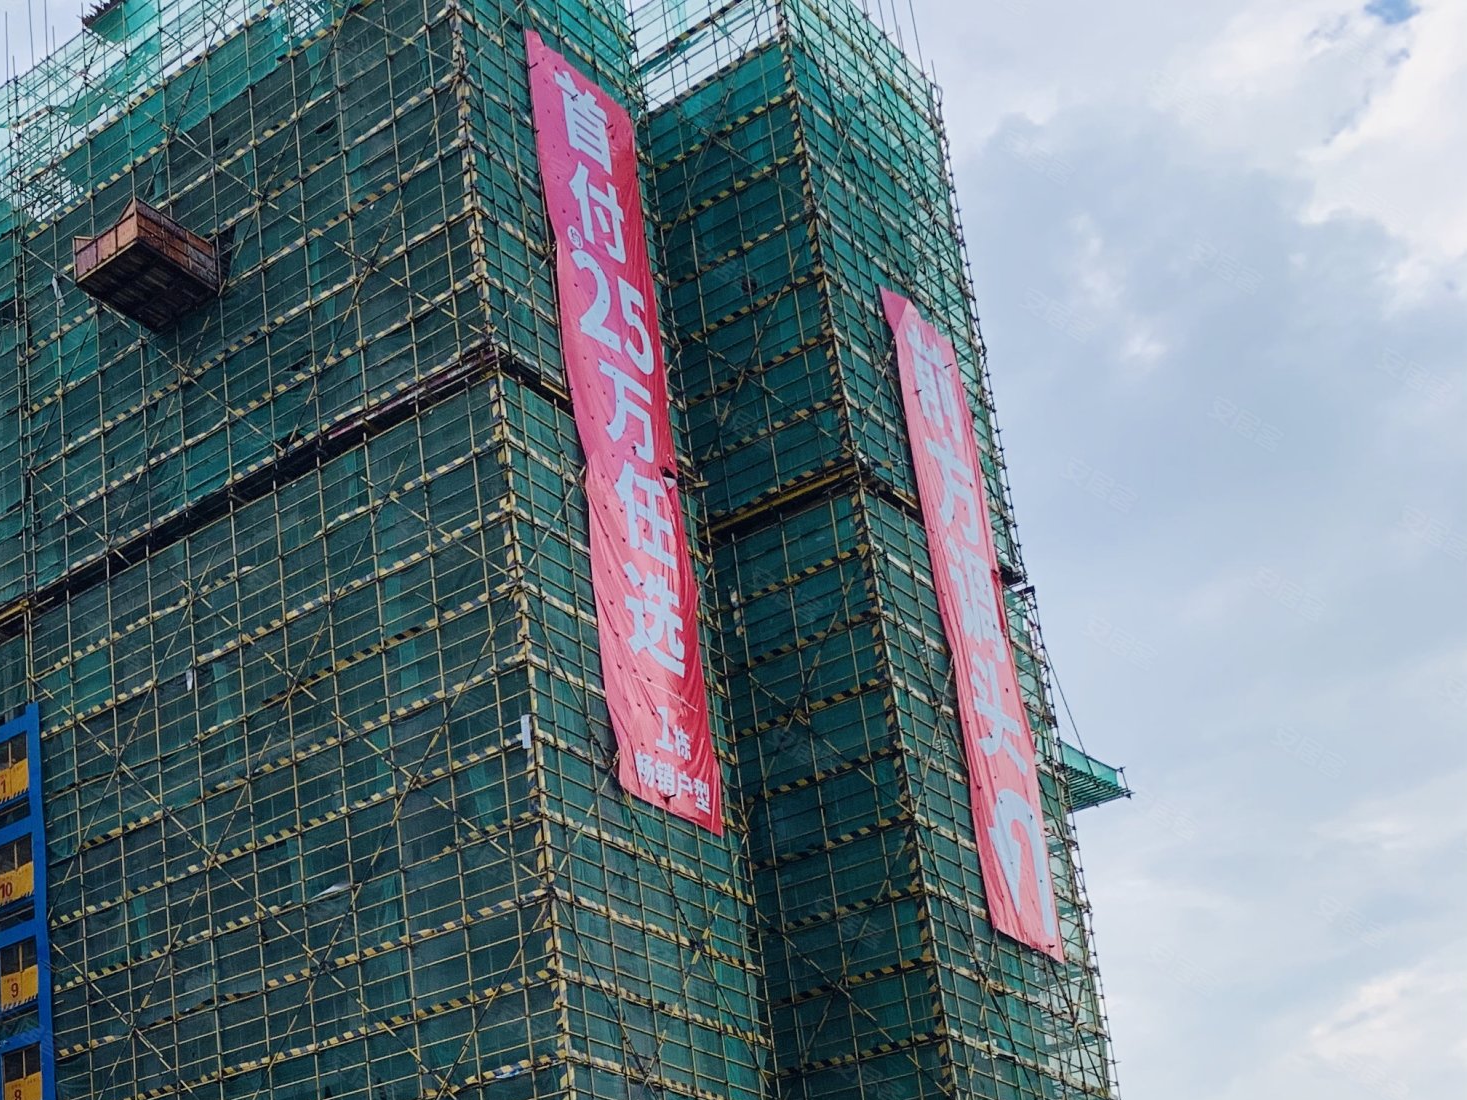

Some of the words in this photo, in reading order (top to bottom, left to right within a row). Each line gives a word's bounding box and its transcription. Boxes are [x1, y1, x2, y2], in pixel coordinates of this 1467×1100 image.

[635, 750, 712, 816] 畅销户型
[0, 882, 13, 898] 10
[10, 983, 19, 998] 9
